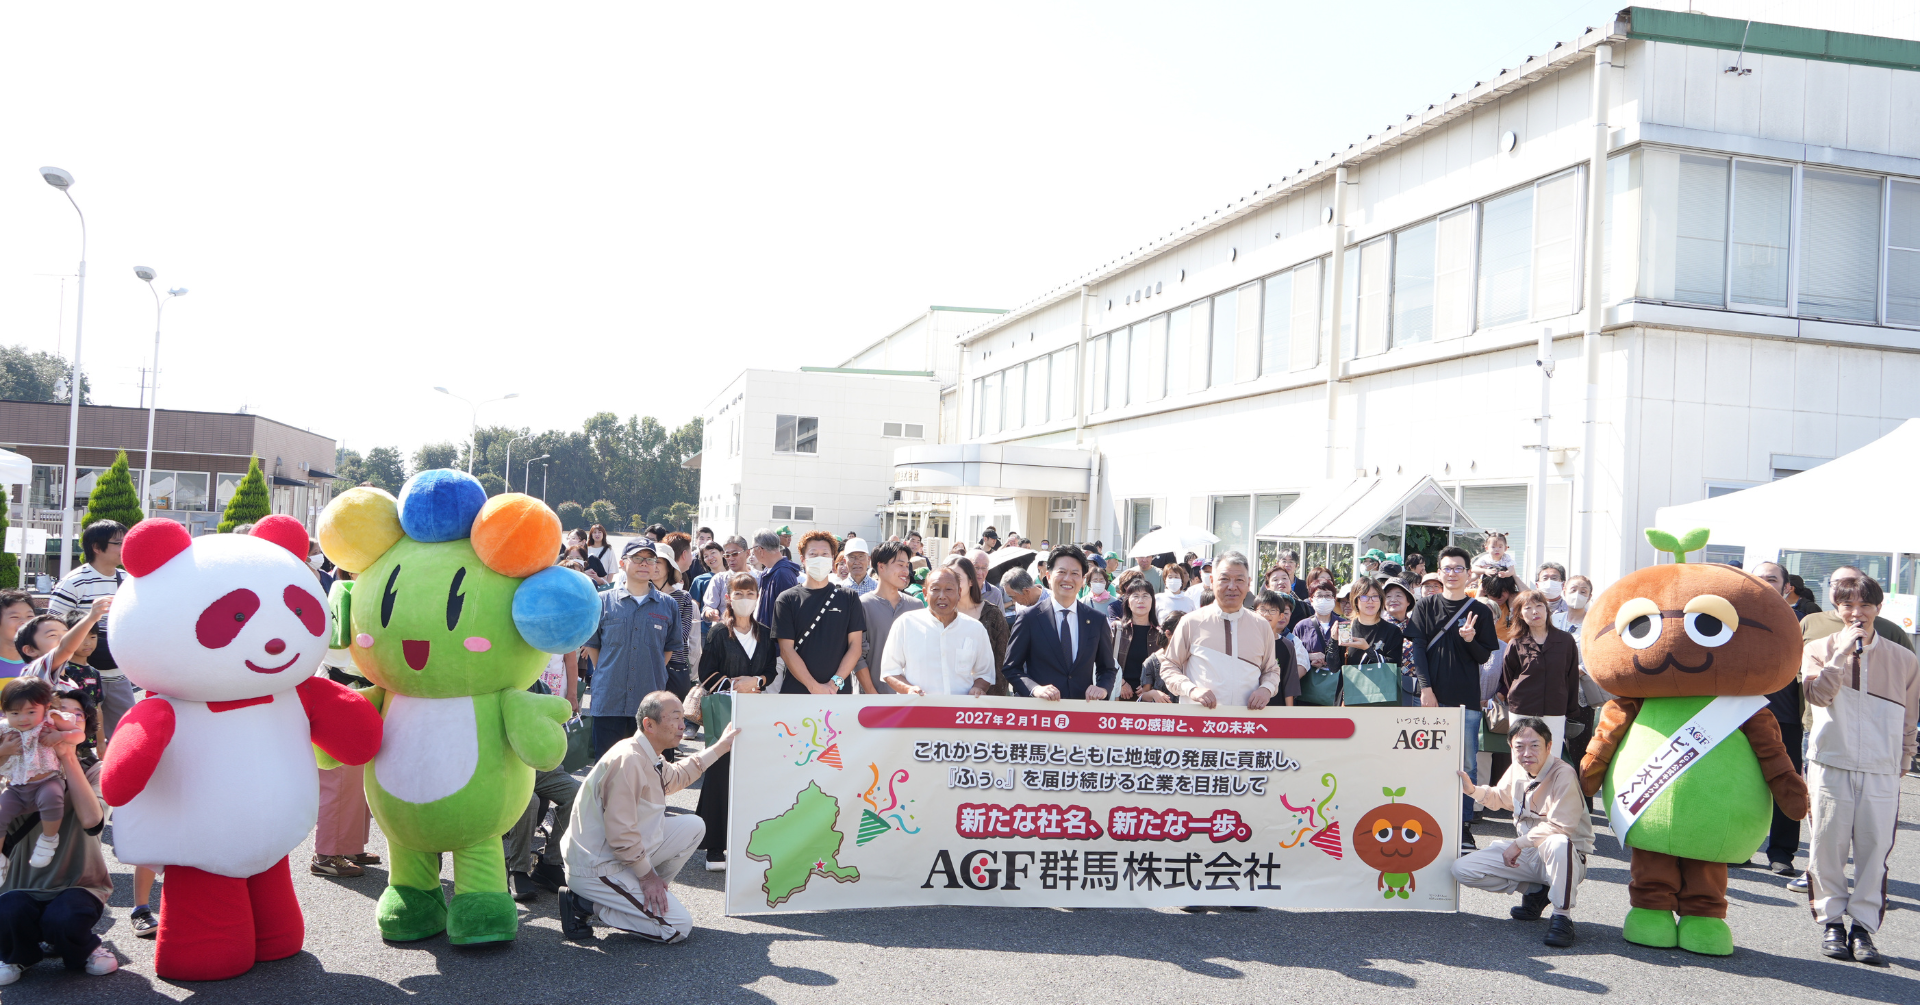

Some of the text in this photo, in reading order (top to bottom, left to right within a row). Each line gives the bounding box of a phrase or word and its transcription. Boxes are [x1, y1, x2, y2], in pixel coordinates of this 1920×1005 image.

[1098, 716, 1268, 734] 30年の感謝と、次の未来へ
[1685, 726, 1711, 747] AGF
[1392, 729, 1447, 750] AGF
[914, 741, 1300, 770] これからも群馬とともに地域の発展に貢献し、
[948, 767, 1268, 793] 『ふぅ。』を届け続ける企業を目指して
[1617, 735, 1690, 806] ビーン太くん
[959, 806, 1250, 838] 新たな社名、新たな一歩。
[920, 849, 1282, 892] AGF群馬株式会社
